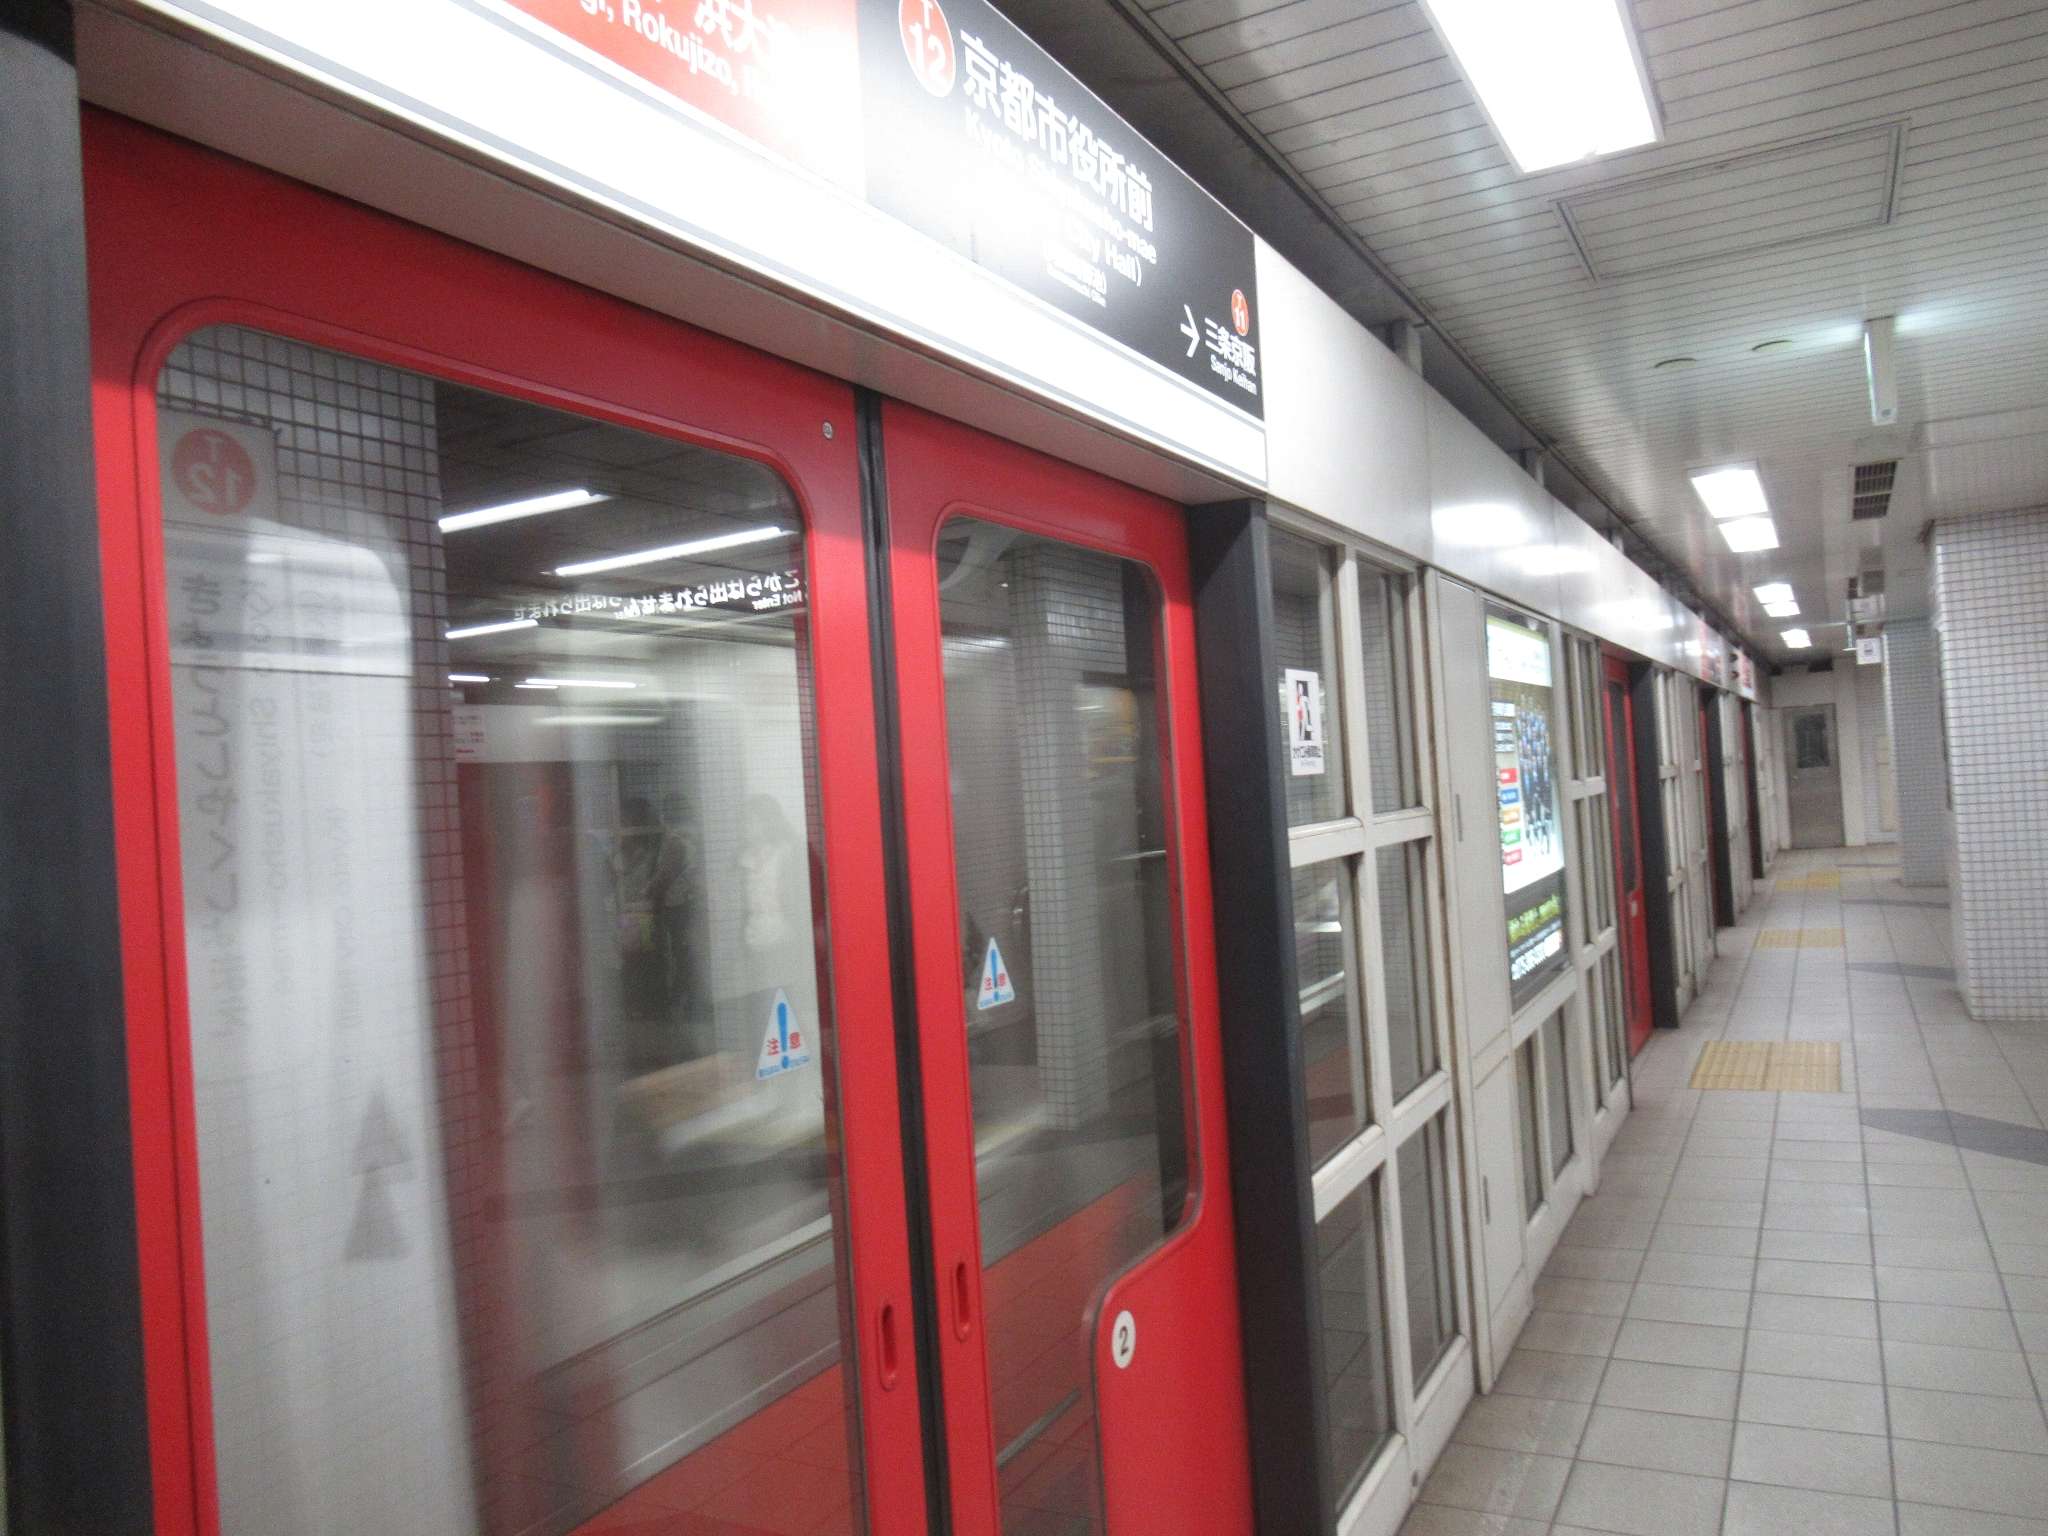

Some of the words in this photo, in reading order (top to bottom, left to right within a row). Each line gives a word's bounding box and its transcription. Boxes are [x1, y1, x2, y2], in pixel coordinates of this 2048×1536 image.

[909, 21, 947, 84] 12
[960, 28, 1153, 232] 京都市役所前
[1204, 317, 1256, 377] 三条京阪
[1119, 1325, 1129, 1357] 2
